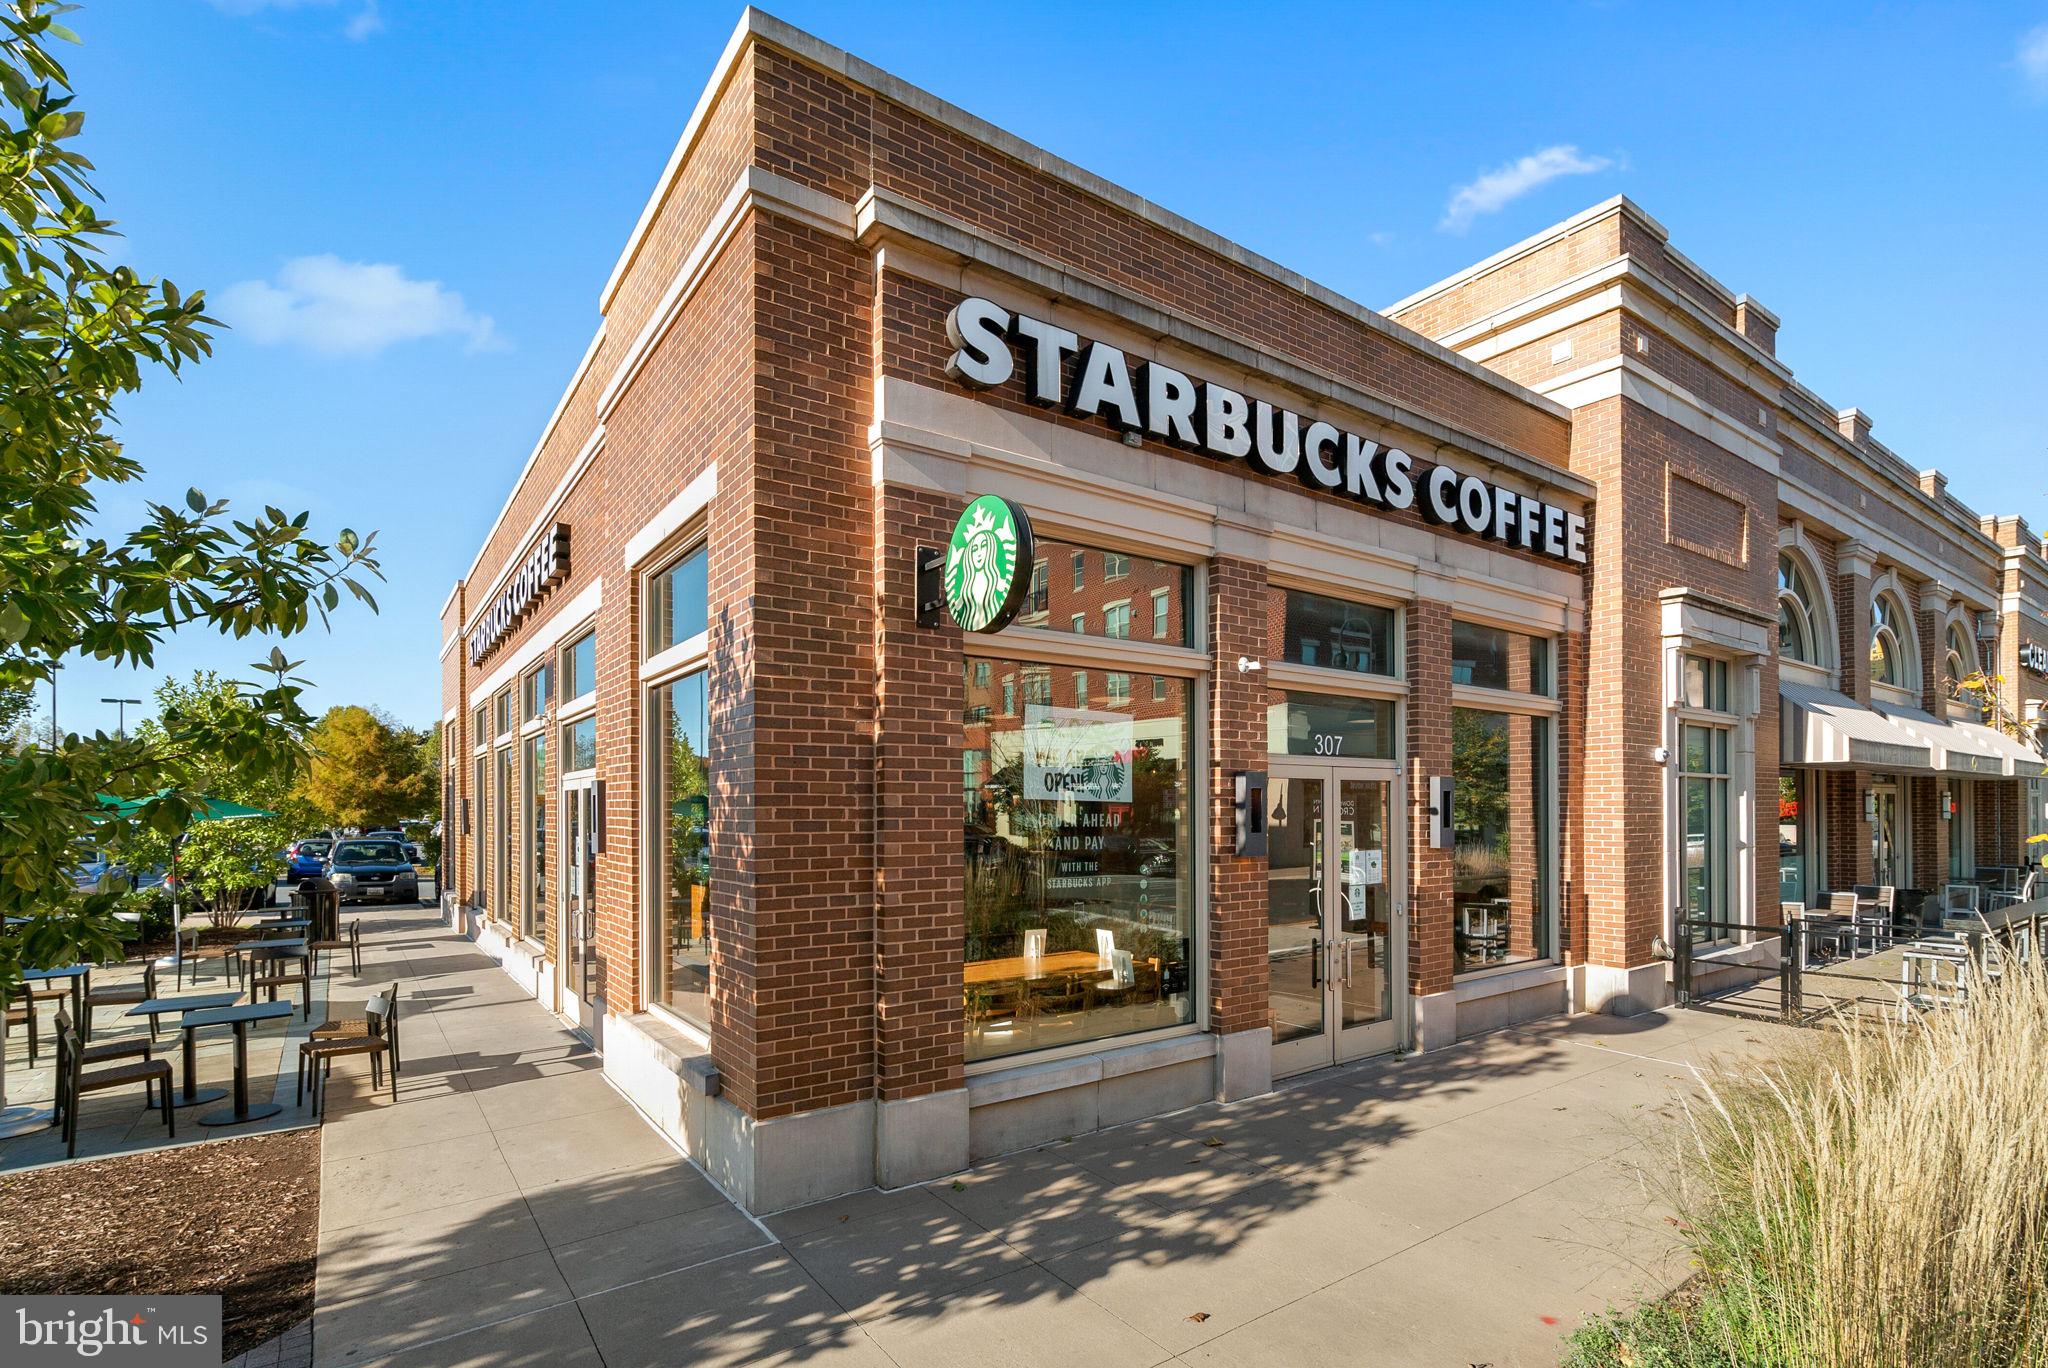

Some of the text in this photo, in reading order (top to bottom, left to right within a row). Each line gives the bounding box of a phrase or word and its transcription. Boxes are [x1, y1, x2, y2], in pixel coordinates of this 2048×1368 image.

[946, 297, 1587, 564] STARBUCKS COFFEE
[470, 522, 564, 666] STARBUCKS COFFEE
[1314, 734, 1343, 755] 307
[1082, 813, 1121, 827] AHEAD
[1055, 836, 1105, 850] AND PAY
[1061, 861, 1099, 872] WITH THE
[1046, 877, 1112, 889] STARBUCKS APP
